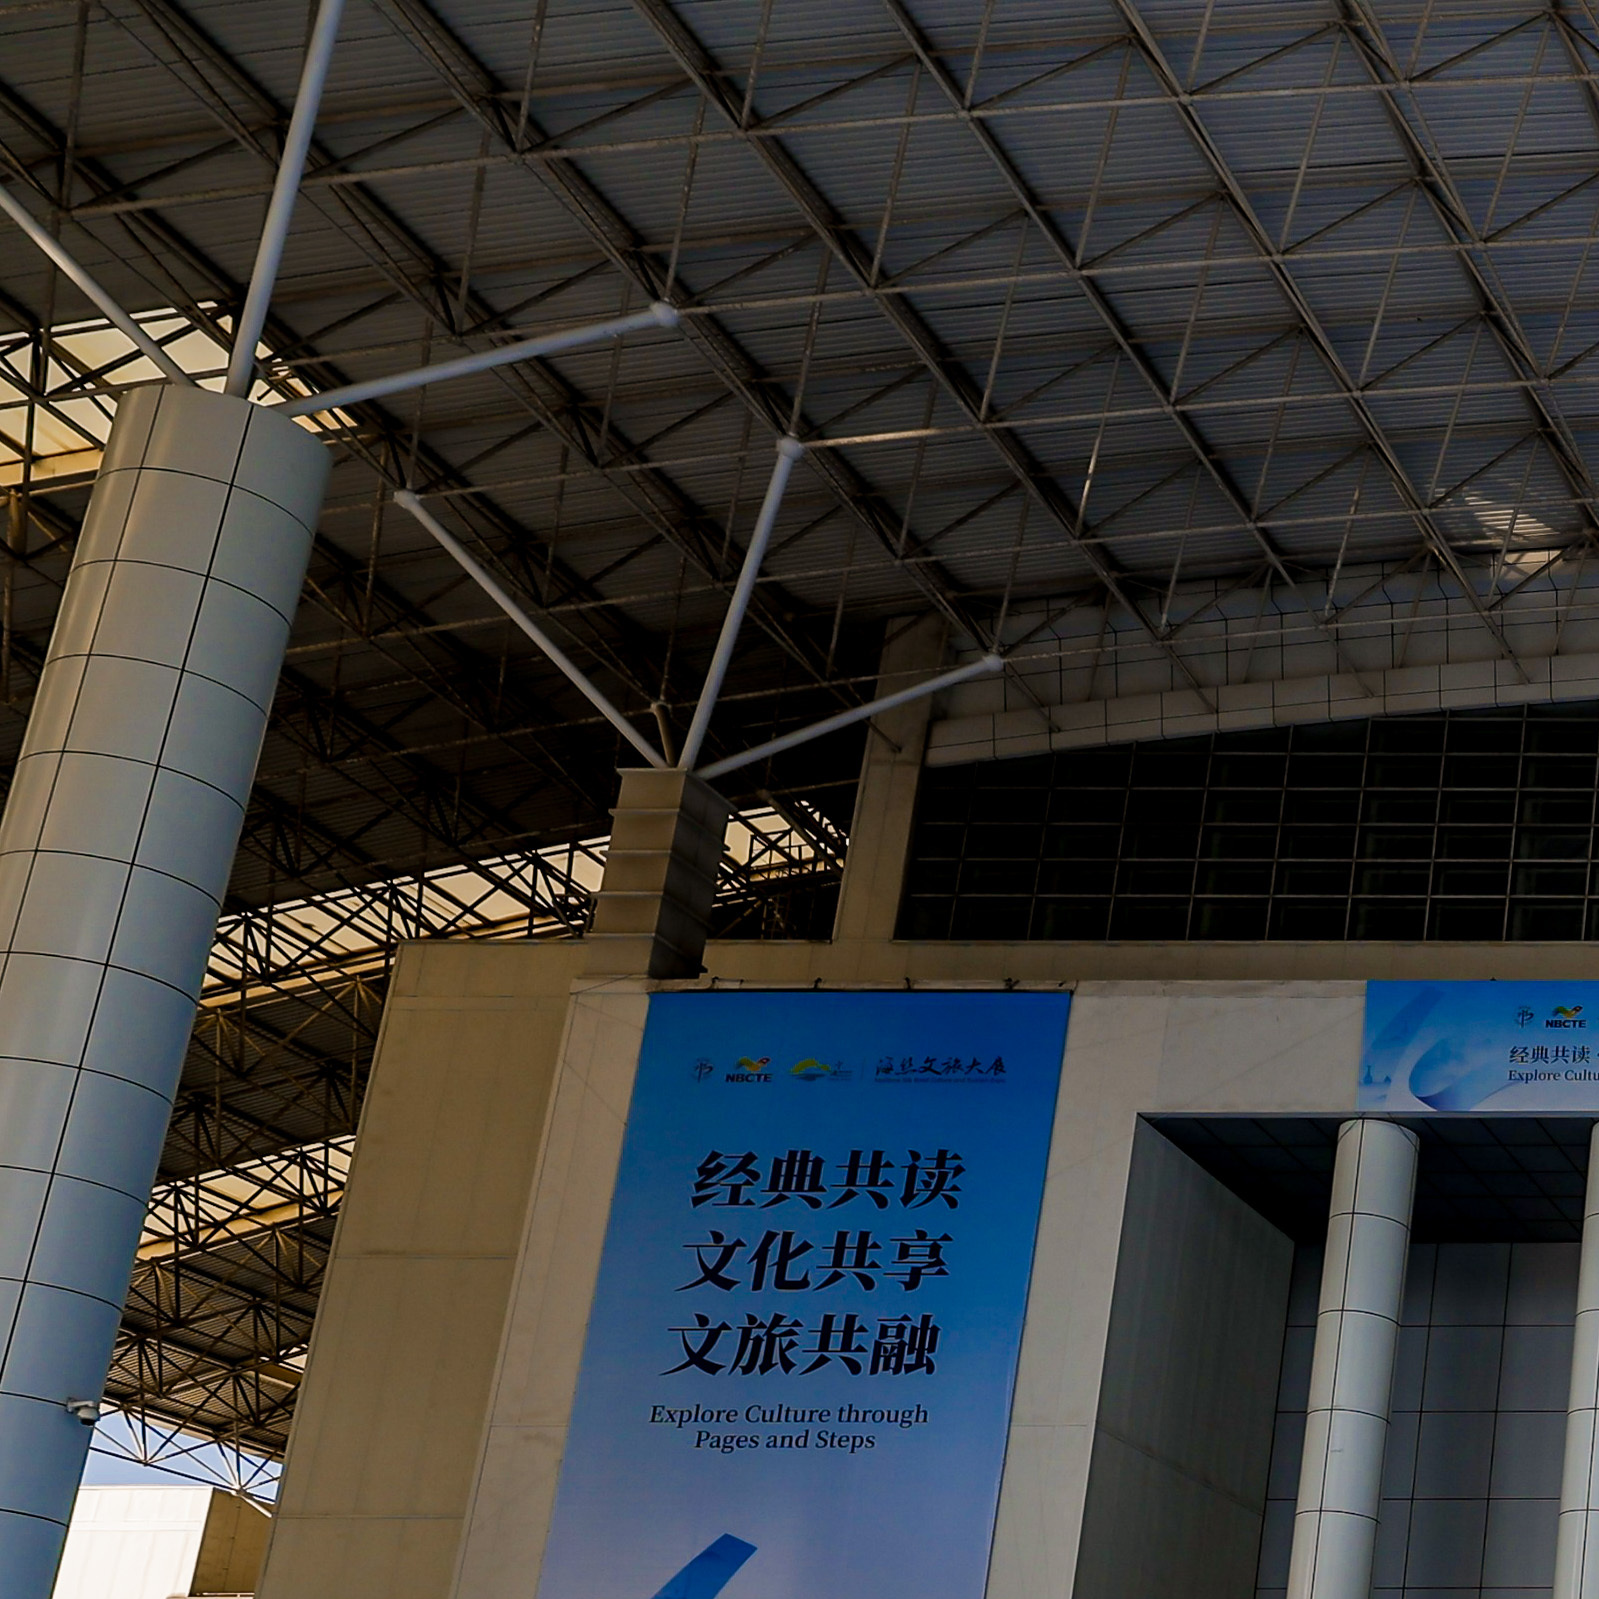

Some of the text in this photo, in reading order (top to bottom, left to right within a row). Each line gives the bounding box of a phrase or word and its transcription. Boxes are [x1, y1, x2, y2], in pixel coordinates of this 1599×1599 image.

[1545, 1019, 1586, 1028] NBCTE
[725, 1073, 772, 1082] NBCTE
[1508, 1069, 1563, 1085] Explore
[690, 1149, 966, 1209] 经典共读
[674, 1230, 953, 1291] 文化共享
[659, 1312, 942, 1376] 文旅共融
[649, 1403, 928, 1428] Explore Culture through
[694, 1429, 876, 1453] Pages and Steps
